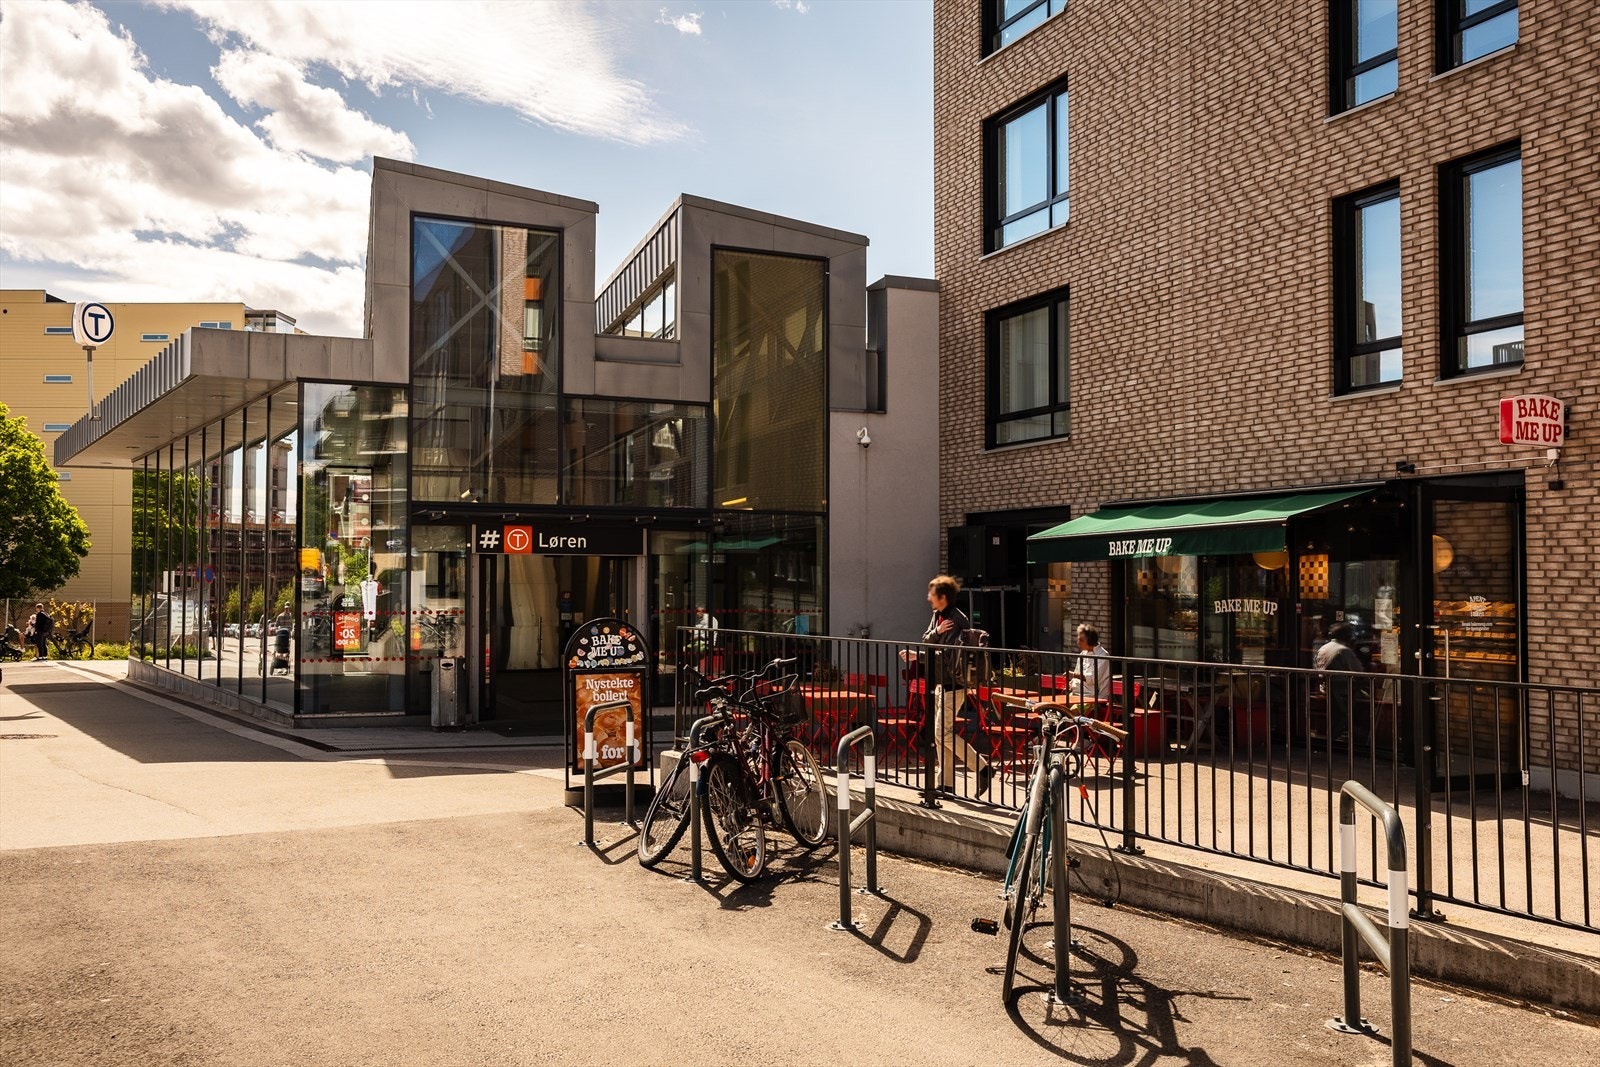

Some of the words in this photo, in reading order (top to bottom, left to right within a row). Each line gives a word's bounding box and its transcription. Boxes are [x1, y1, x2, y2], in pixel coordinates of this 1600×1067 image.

[88, 312, 105, 336] T
[1516, 398, 1560, 421] BAKE
[1515, 421, 1539, 441] ME
[1542, 423, 1562, 442] UP
[538, 532, 587, 548] Løren
[1108, 539, 1136, 556] BAKE
[1136, 538, 1154, 554] ME
[1156, 537, 1172, 553] UP
[1214, 598, 1242, 614] BAKE
[1243, 599, 1261, 613] ME
[1263, 601, 1278, 616] UP
[591, 634, 622, 647] BAKE
[591, 646, 608, 657] ME
[586, 678, 634, 692] Nystekte
[592, 689, 628, 701] boller!
[601, 744, 624, 759] for
